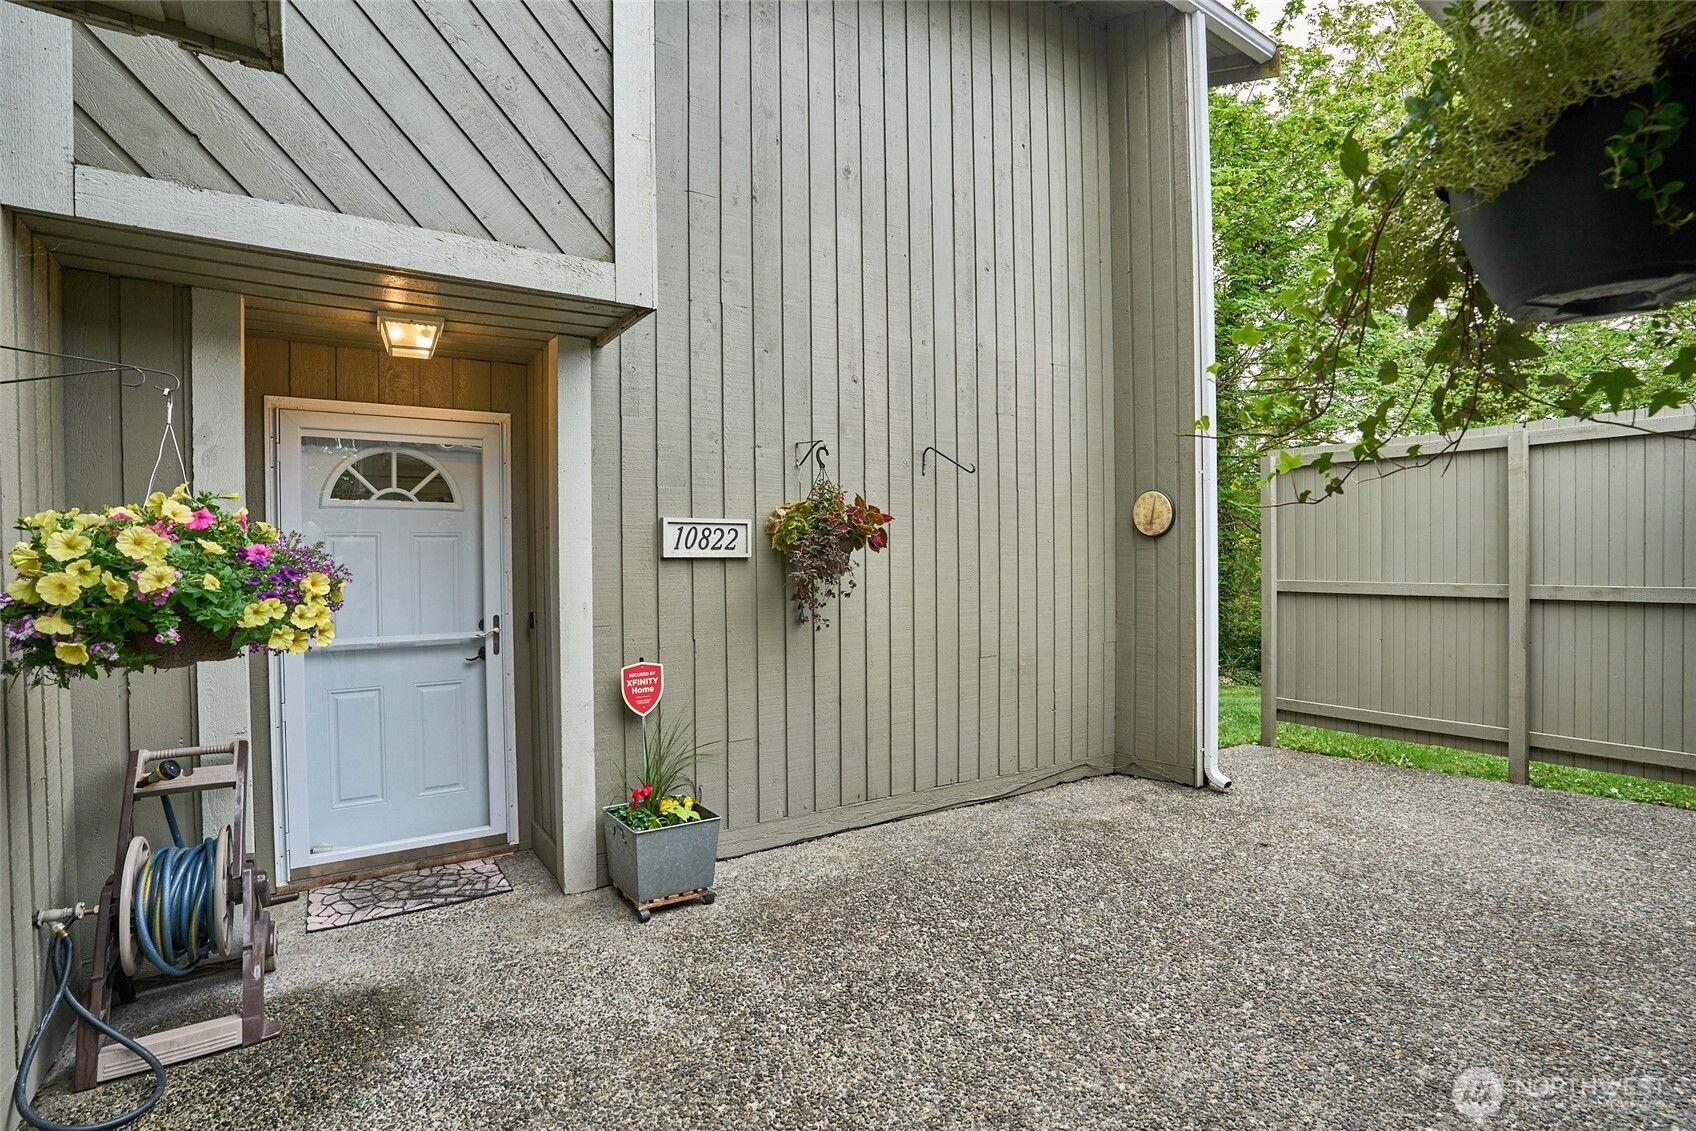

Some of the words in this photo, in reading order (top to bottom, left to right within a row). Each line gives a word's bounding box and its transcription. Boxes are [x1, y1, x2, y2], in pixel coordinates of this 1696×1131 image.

[673, 526, 739, 551] 10822
[626, 677, 659, 687] XFINITY
[631, 686, 655, 694] Home
